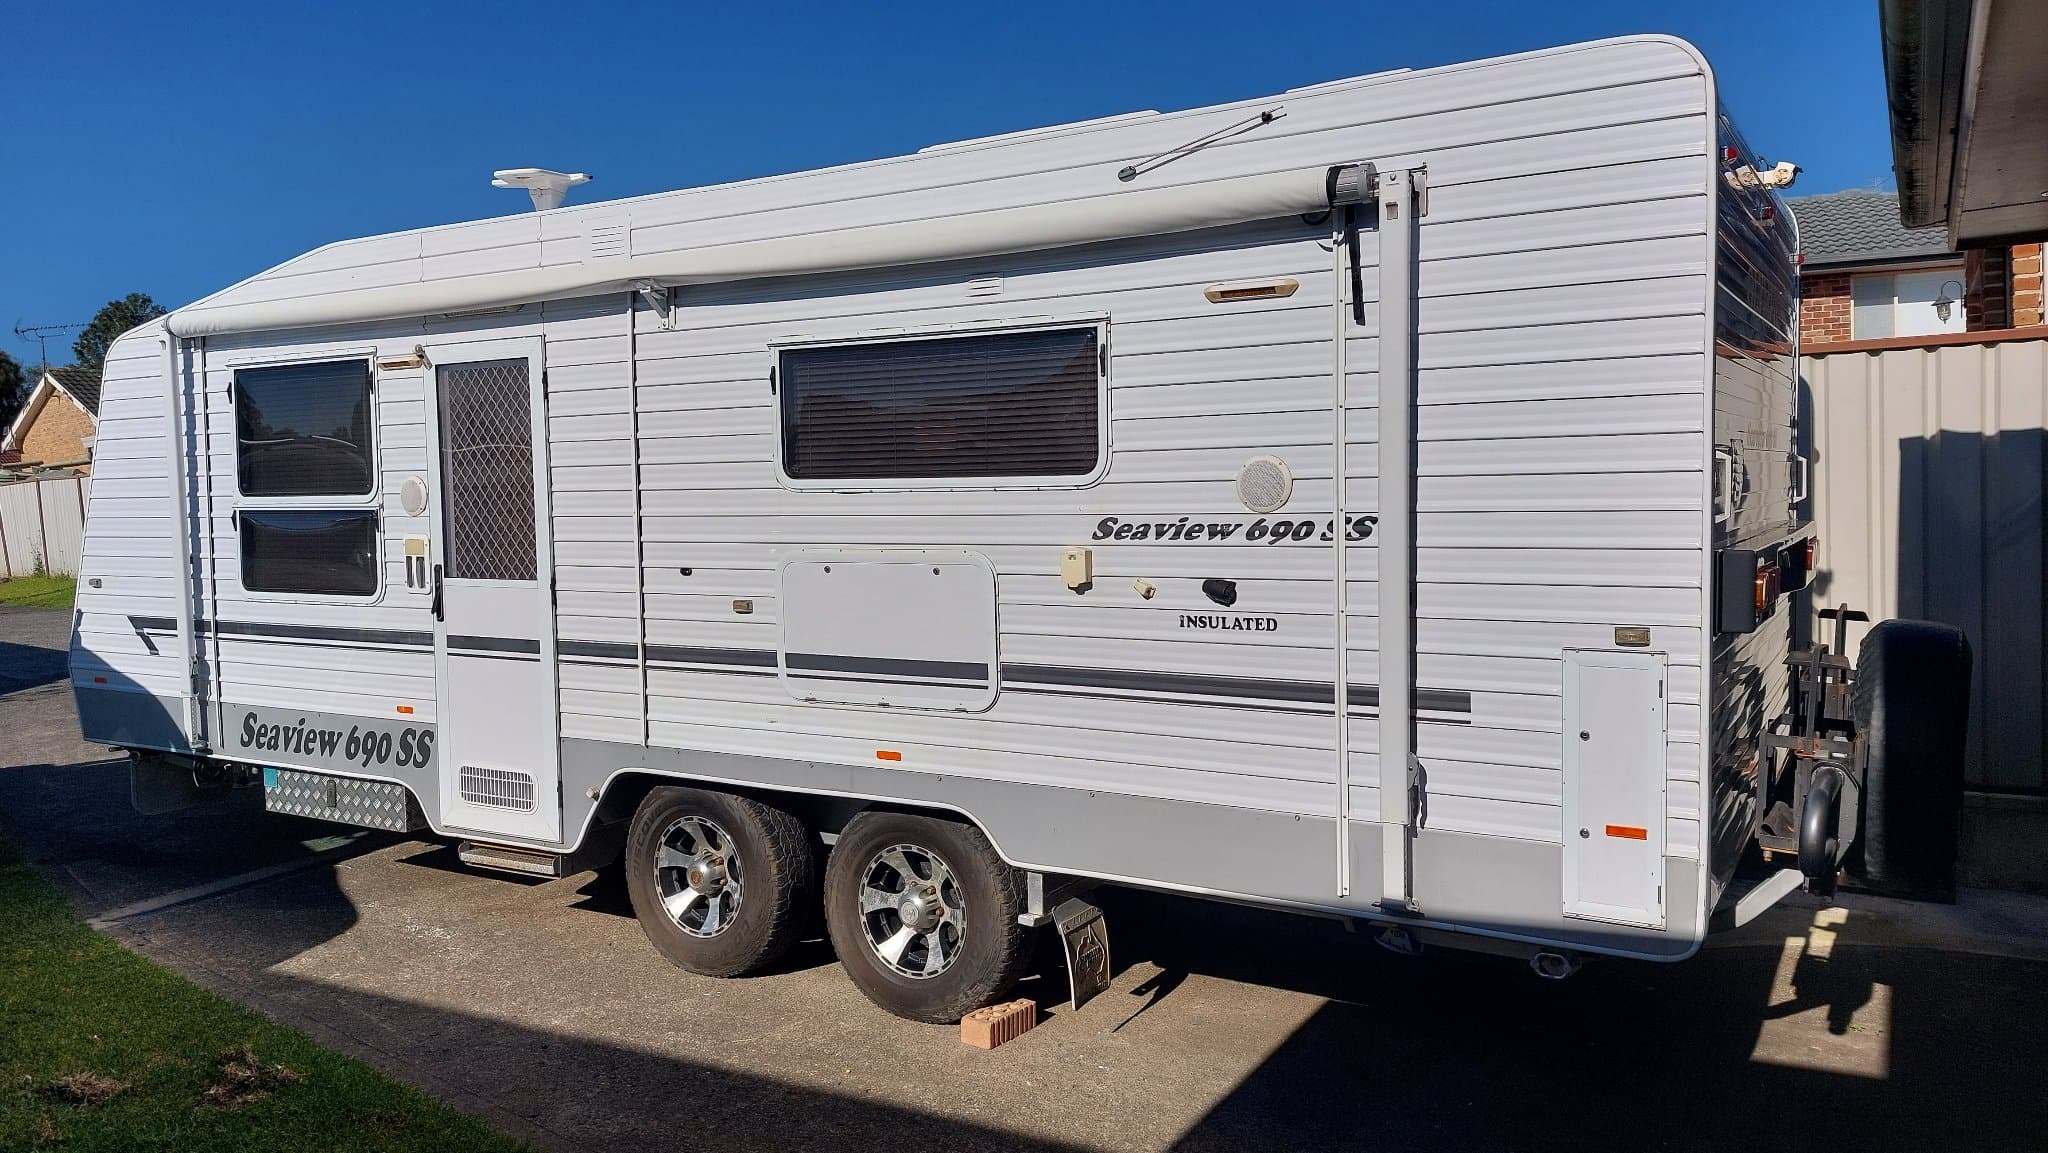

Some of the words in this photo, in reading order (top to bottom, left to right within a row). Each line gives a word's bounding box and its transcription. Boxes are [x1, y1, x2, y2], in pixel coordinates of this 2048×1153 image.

[1092, 516, 1243, 541] Seaview
[1245, 518, 1315, 545] 690
[240, 712, 343, 758] Seaview
[345, 725, 392, 768] 690
[395, 727, 435, 769] SS
